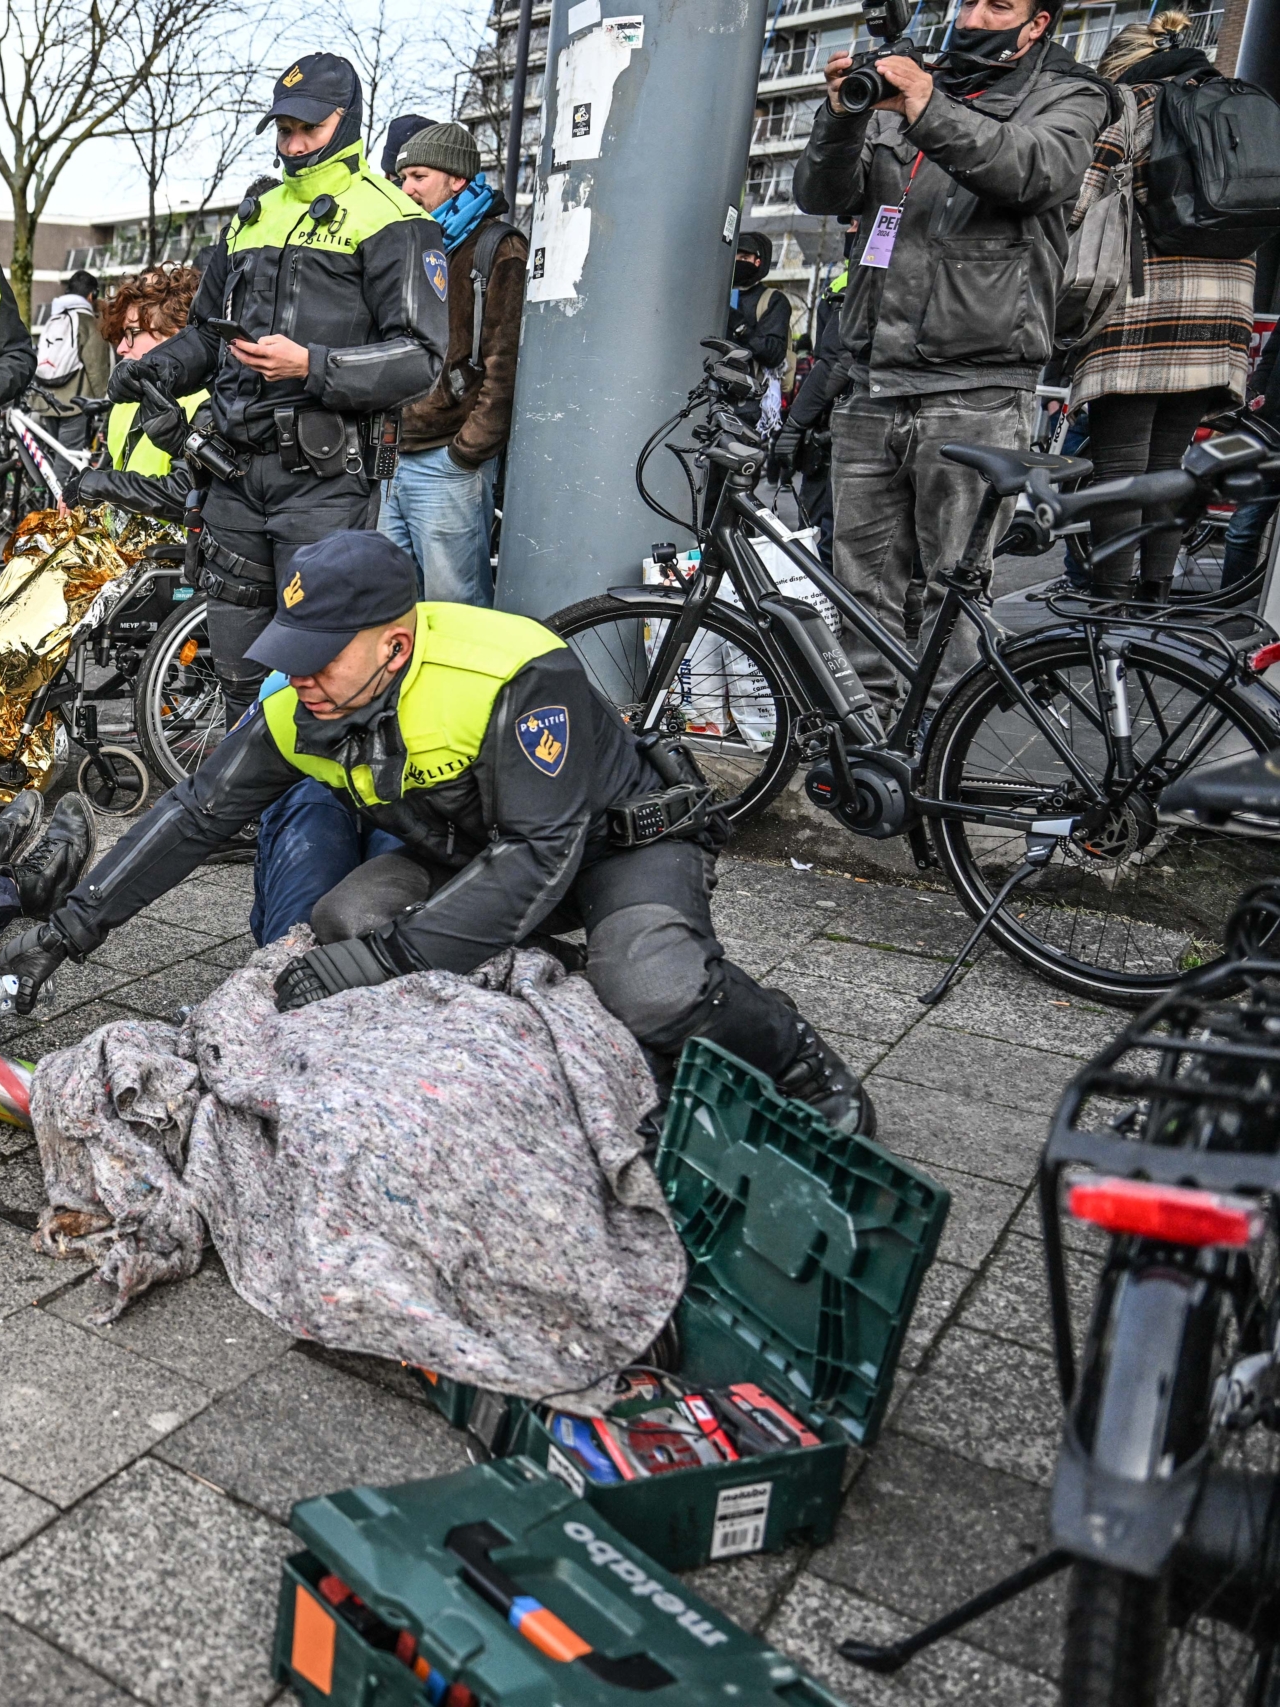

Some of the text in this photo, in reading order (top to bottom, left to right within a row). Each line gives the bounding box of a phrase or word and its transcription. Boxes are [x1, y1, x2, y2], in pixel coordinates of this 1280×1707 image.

[298, 231, 352, 247] POLITIE
[822, 649, 843, 661] PACE
[520, 713, 565, 733] POLITIE
[563, 1521, 729, 1647] metabo
